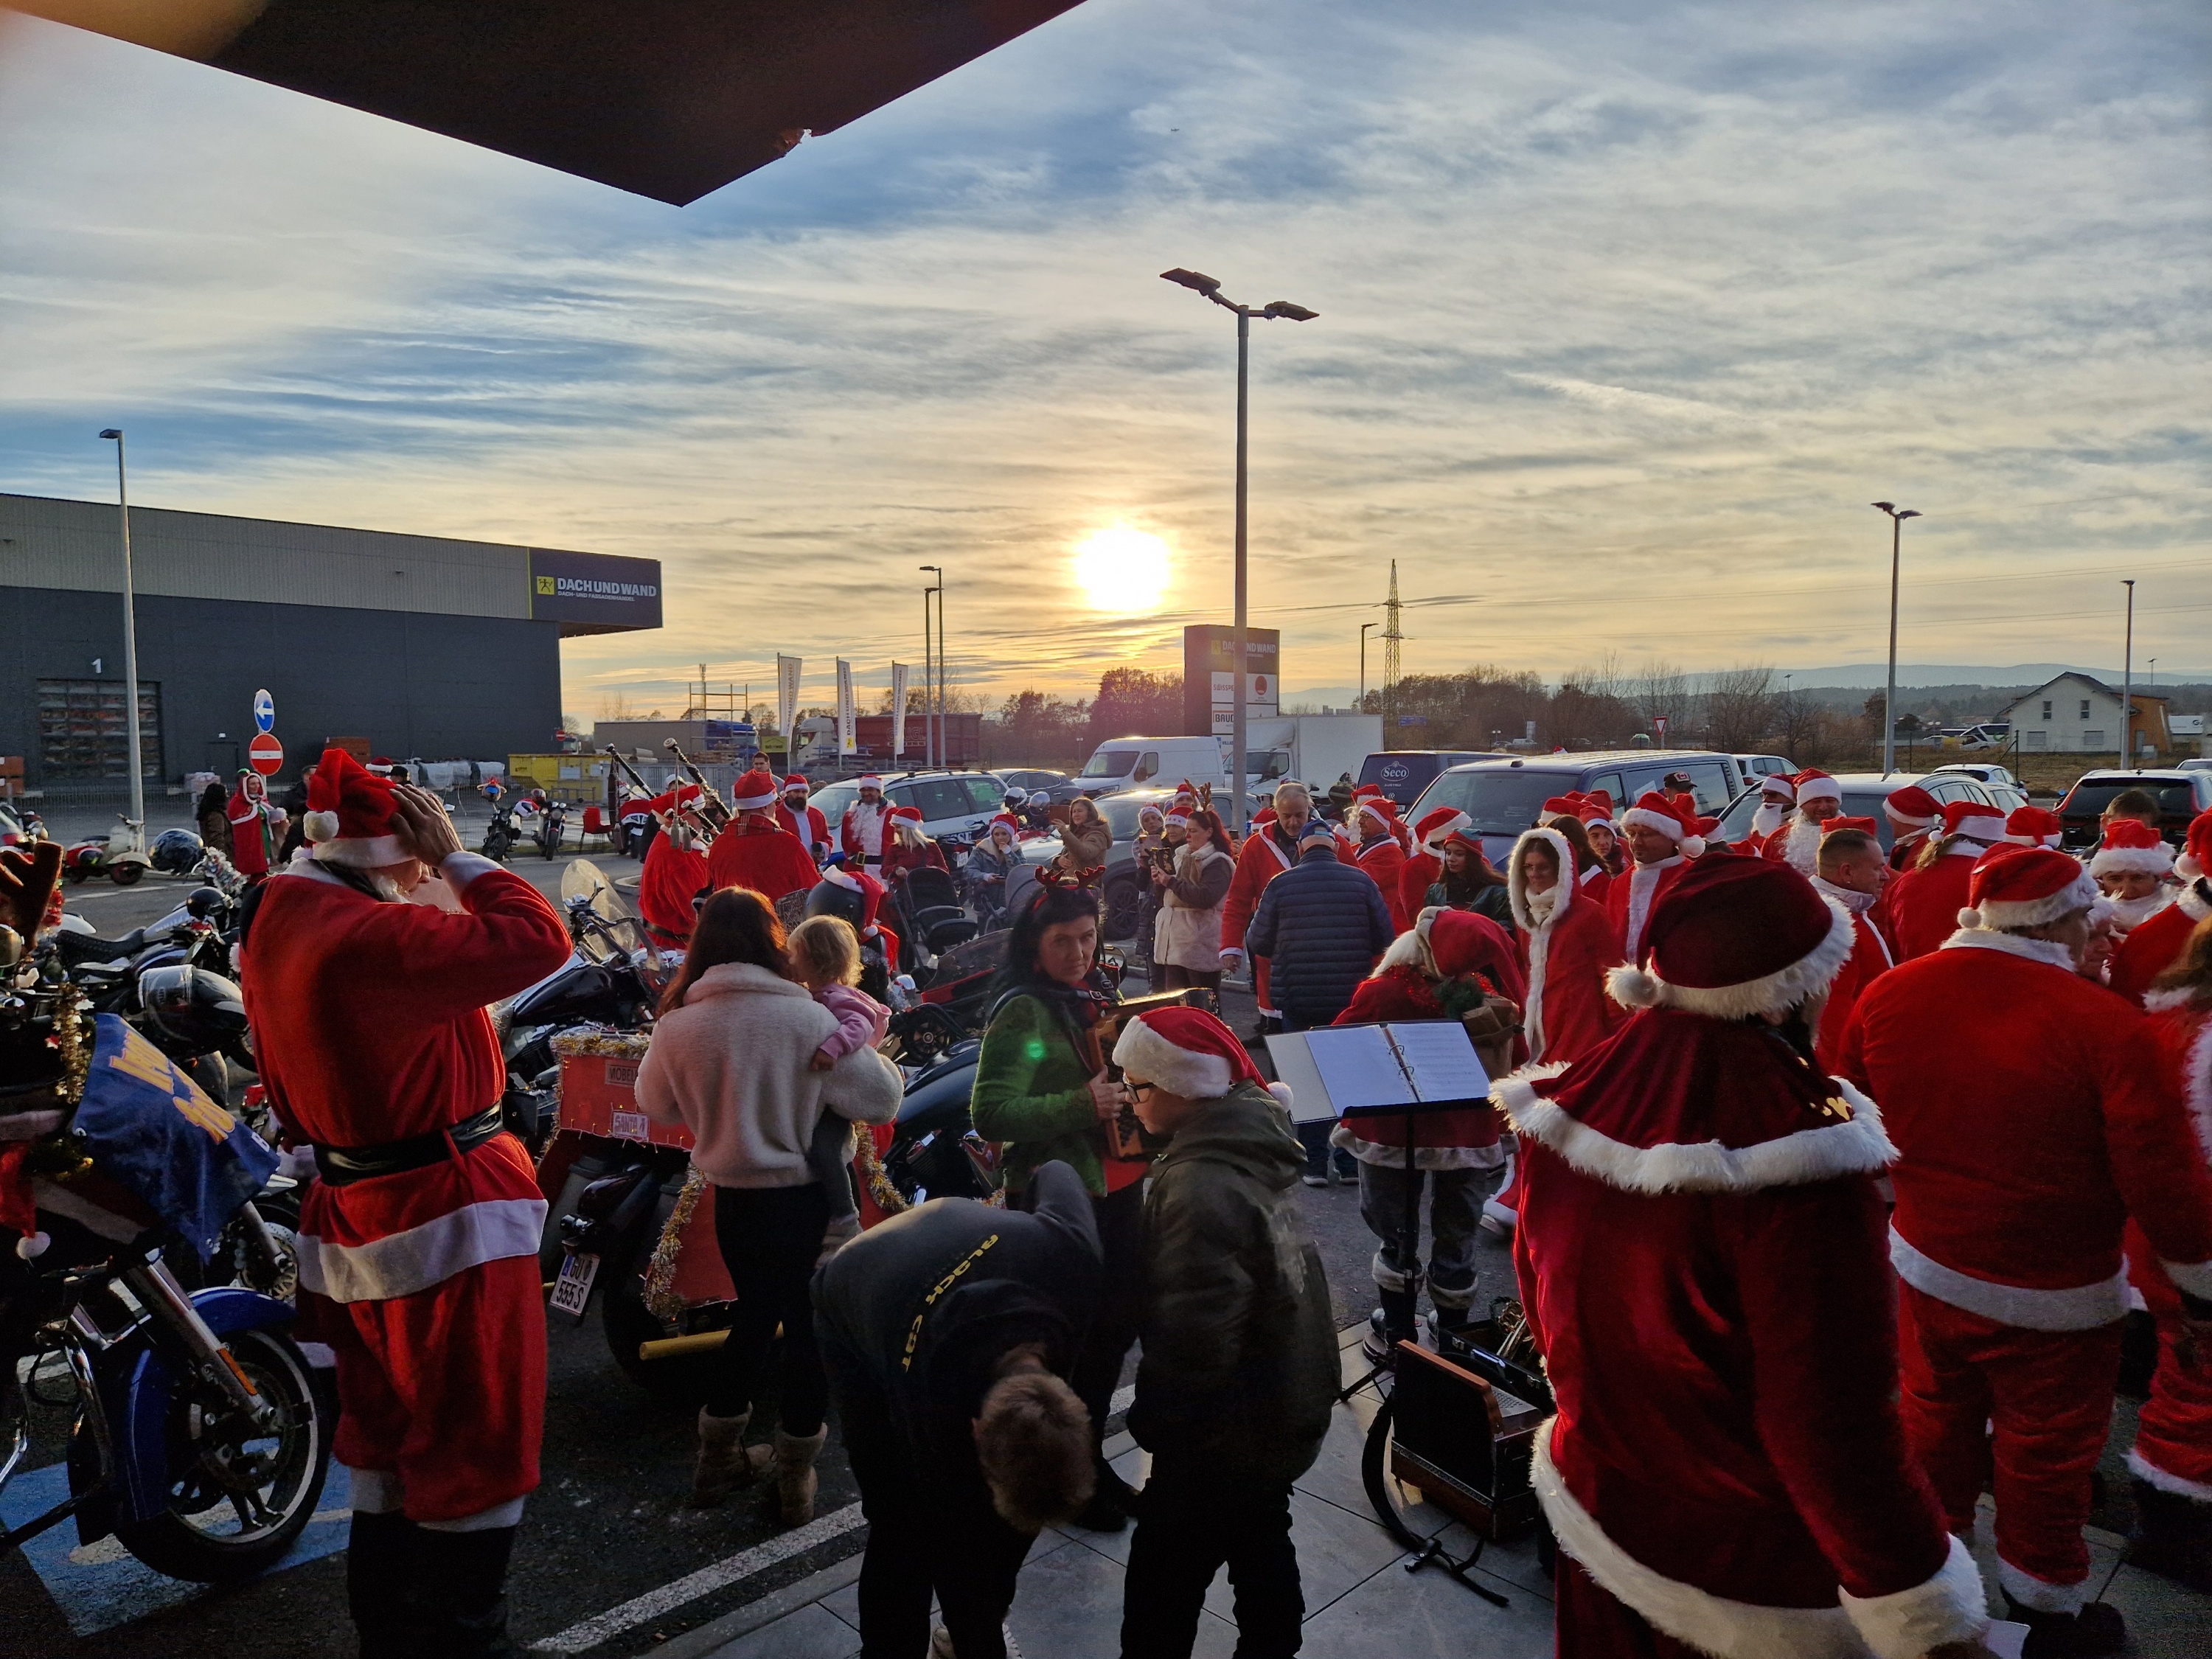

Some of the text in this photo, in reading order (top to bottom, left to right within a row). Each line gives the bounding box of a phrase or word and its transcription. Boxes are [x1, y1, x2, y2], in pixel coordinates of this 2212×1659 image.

[557, 577, 657, 597] DACH UND WAND
[91, 658, 102, 674] 1
[1383, 768, 1407, 777] Seco
